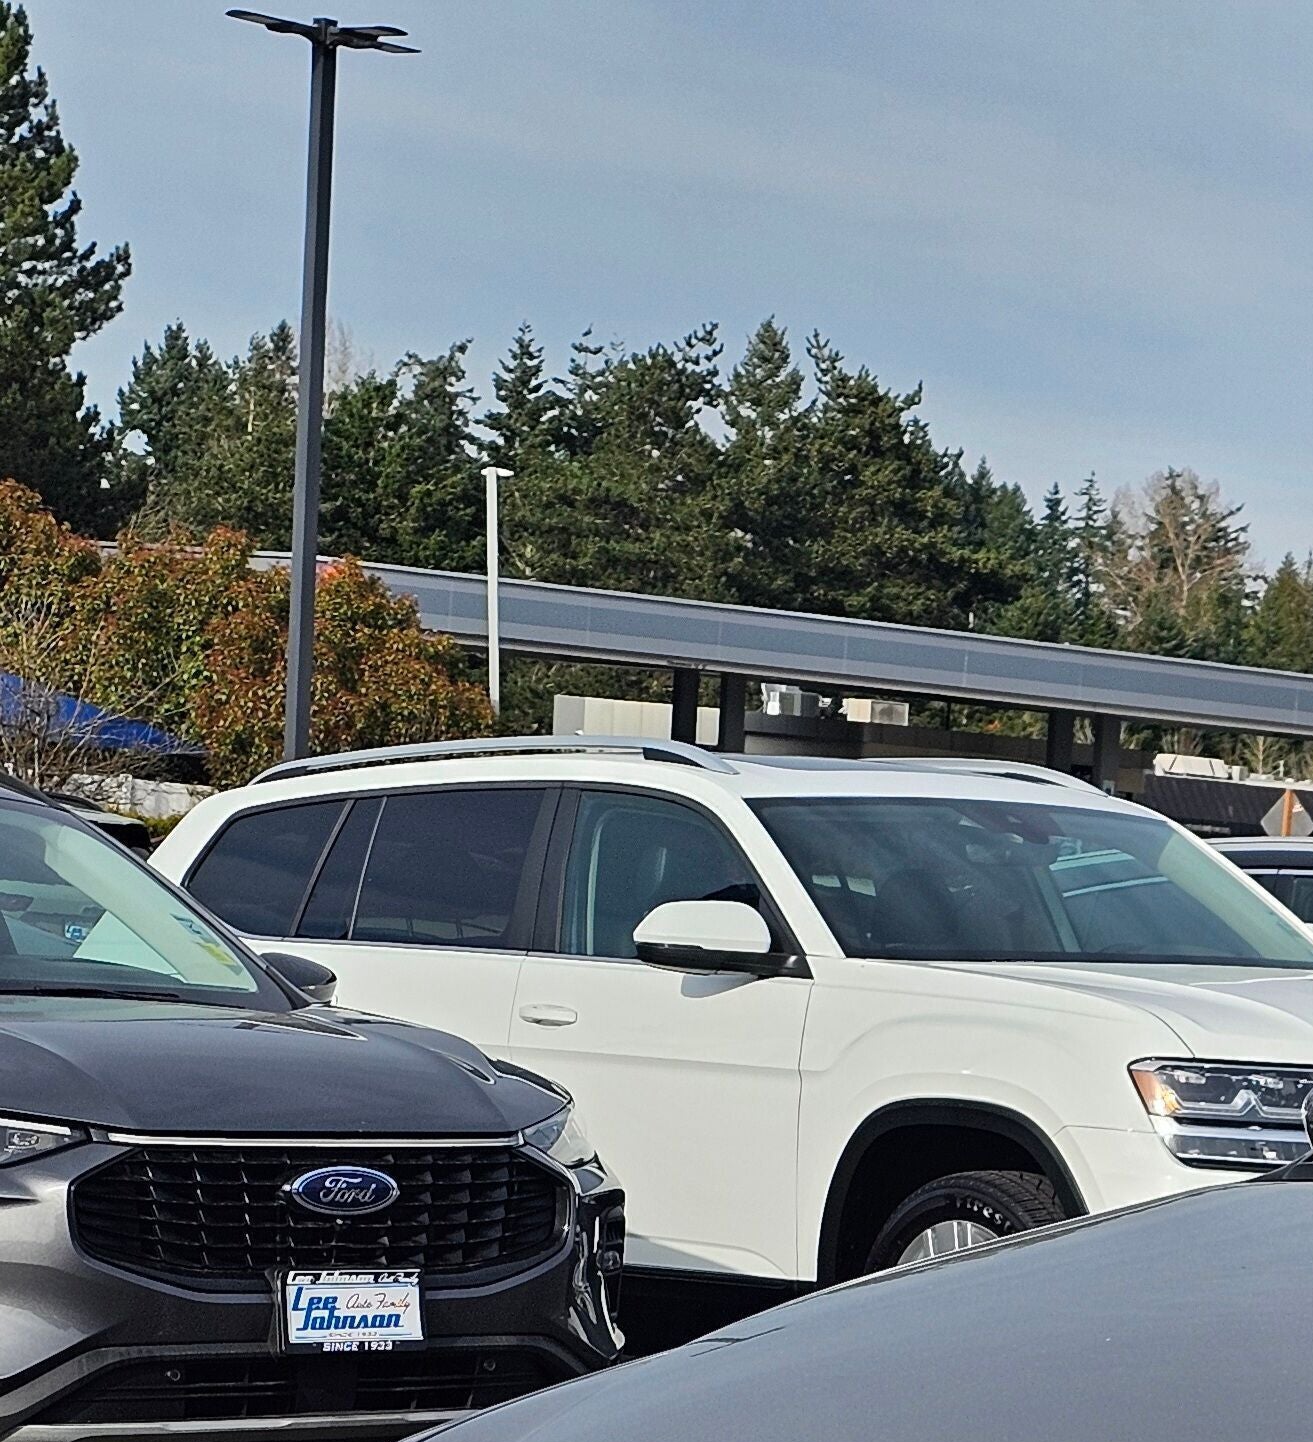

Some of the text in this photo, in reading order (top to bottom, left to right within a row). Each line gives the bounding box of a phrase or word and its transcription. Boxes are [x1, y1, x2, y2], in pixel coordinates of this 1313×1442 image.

[319, 1176, 377, 1203] Ford
[292, 1286, 341, 1311] Lee
[346, 1293, 372, 1310] Auto
[296, 1306, 404, 1331] Johnson
[322, 1341, 393, 1352] SINCE 1933
